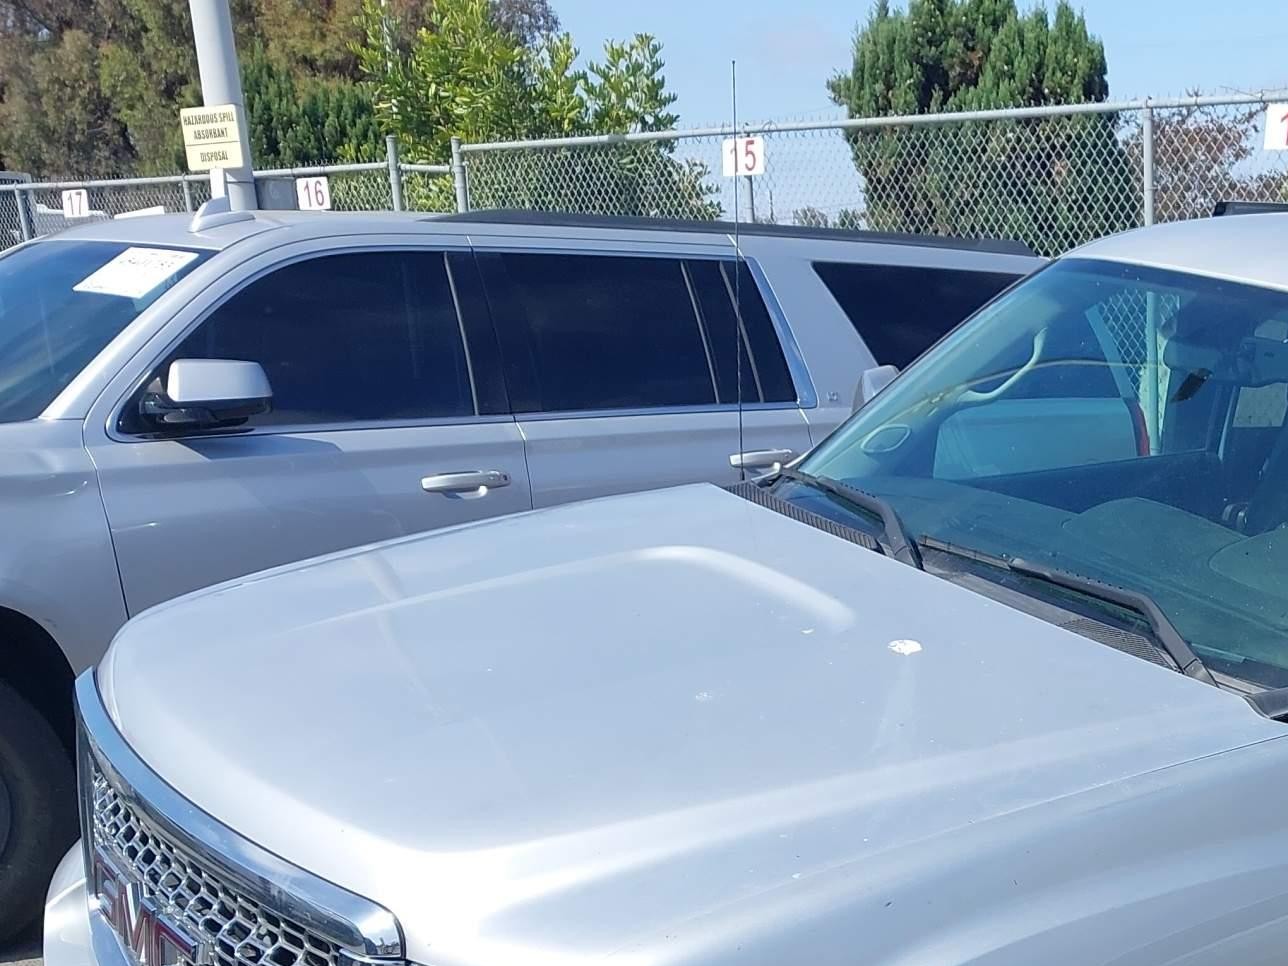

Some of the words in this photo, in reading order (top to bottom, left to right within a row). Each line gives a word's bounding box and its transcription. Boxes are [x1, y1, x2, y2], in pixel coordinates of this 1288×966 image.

[183, 113, 218, 126] HAZARDOUS
[219, 111, 235, 122] SPILL
[200, 150, 229, 162] DISPOSAL
[730, 139, 756, 172] 15
[68, 190, 83, 216] 17
[303, 180, 325, 208] 16
